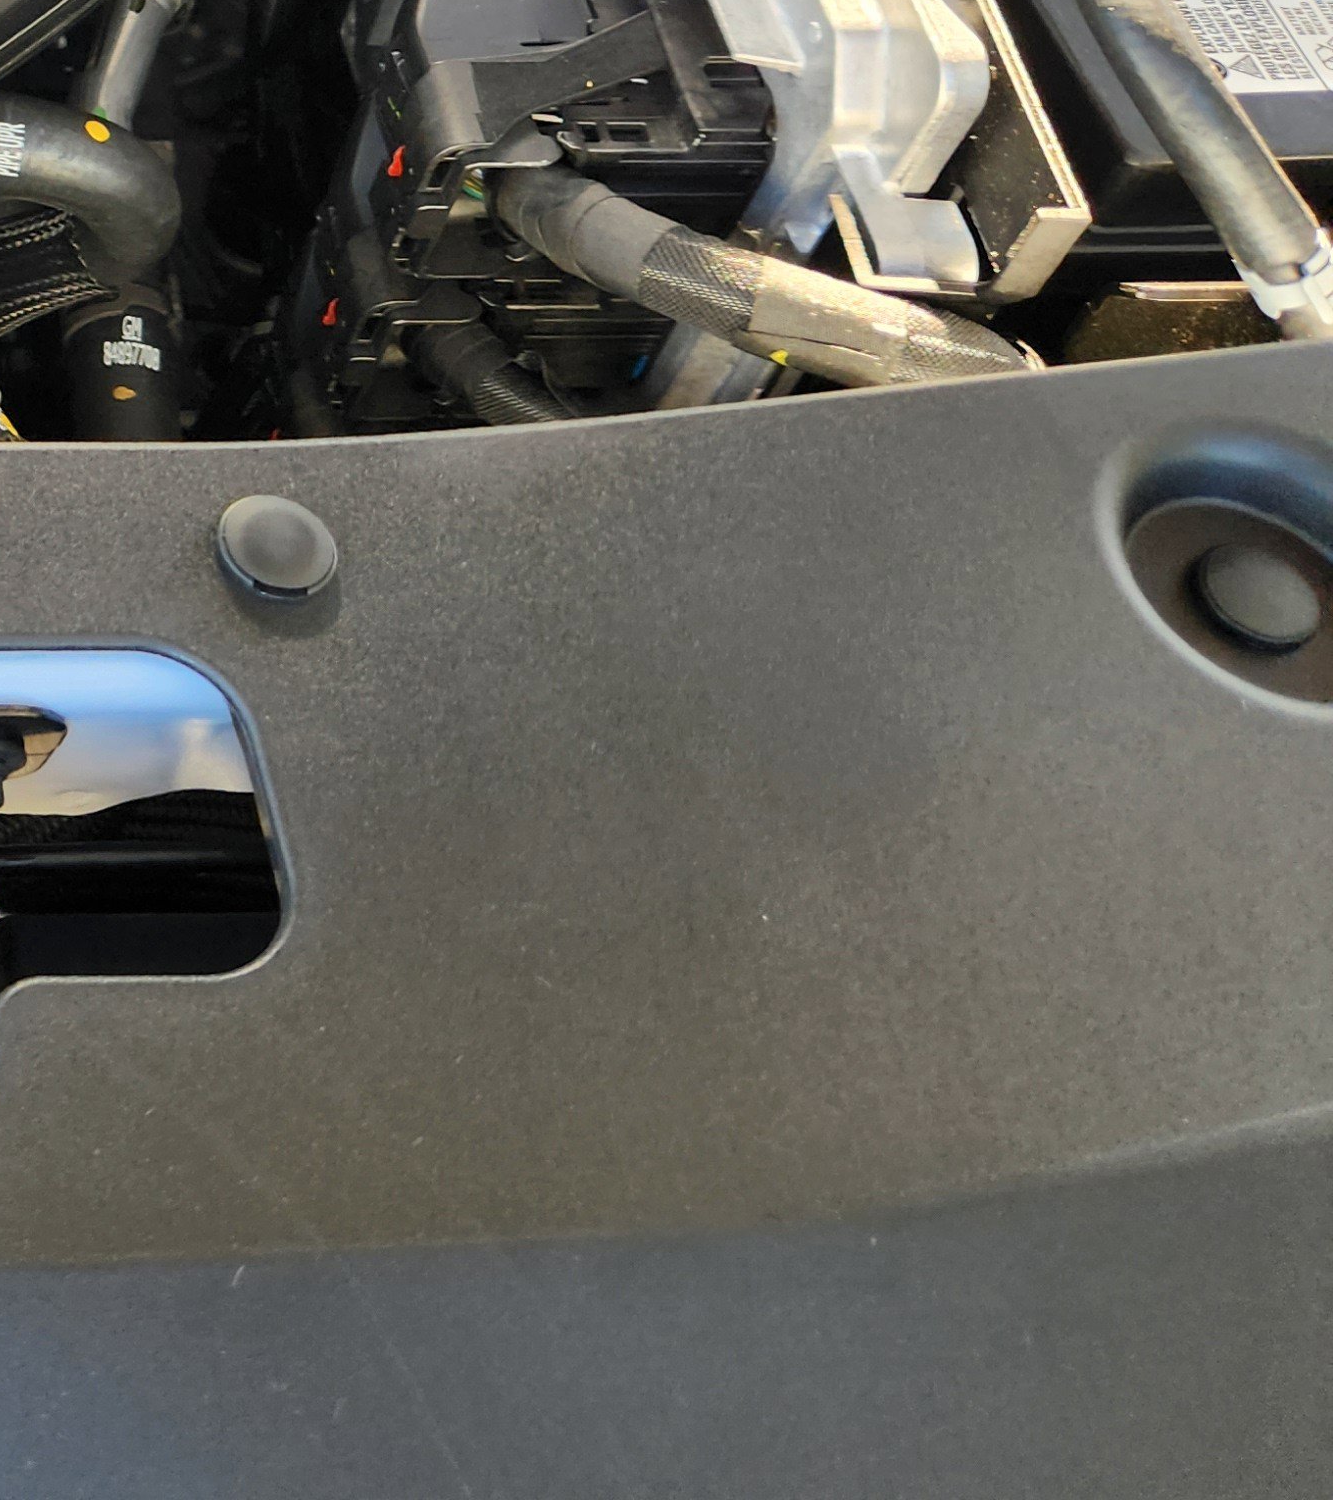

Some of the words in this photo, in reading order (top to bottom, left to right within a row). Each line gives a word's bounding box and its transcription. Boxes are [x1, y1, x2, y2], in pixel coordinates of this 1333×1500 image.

[1191, 8, 1221, 34] CAUSE
[1228, 14, 1250, 29] LES
[1263, 42, 1287, 60] GAZ
[1277, 62, 1300, 79] LES
[121, 315, 142, 341] GM
